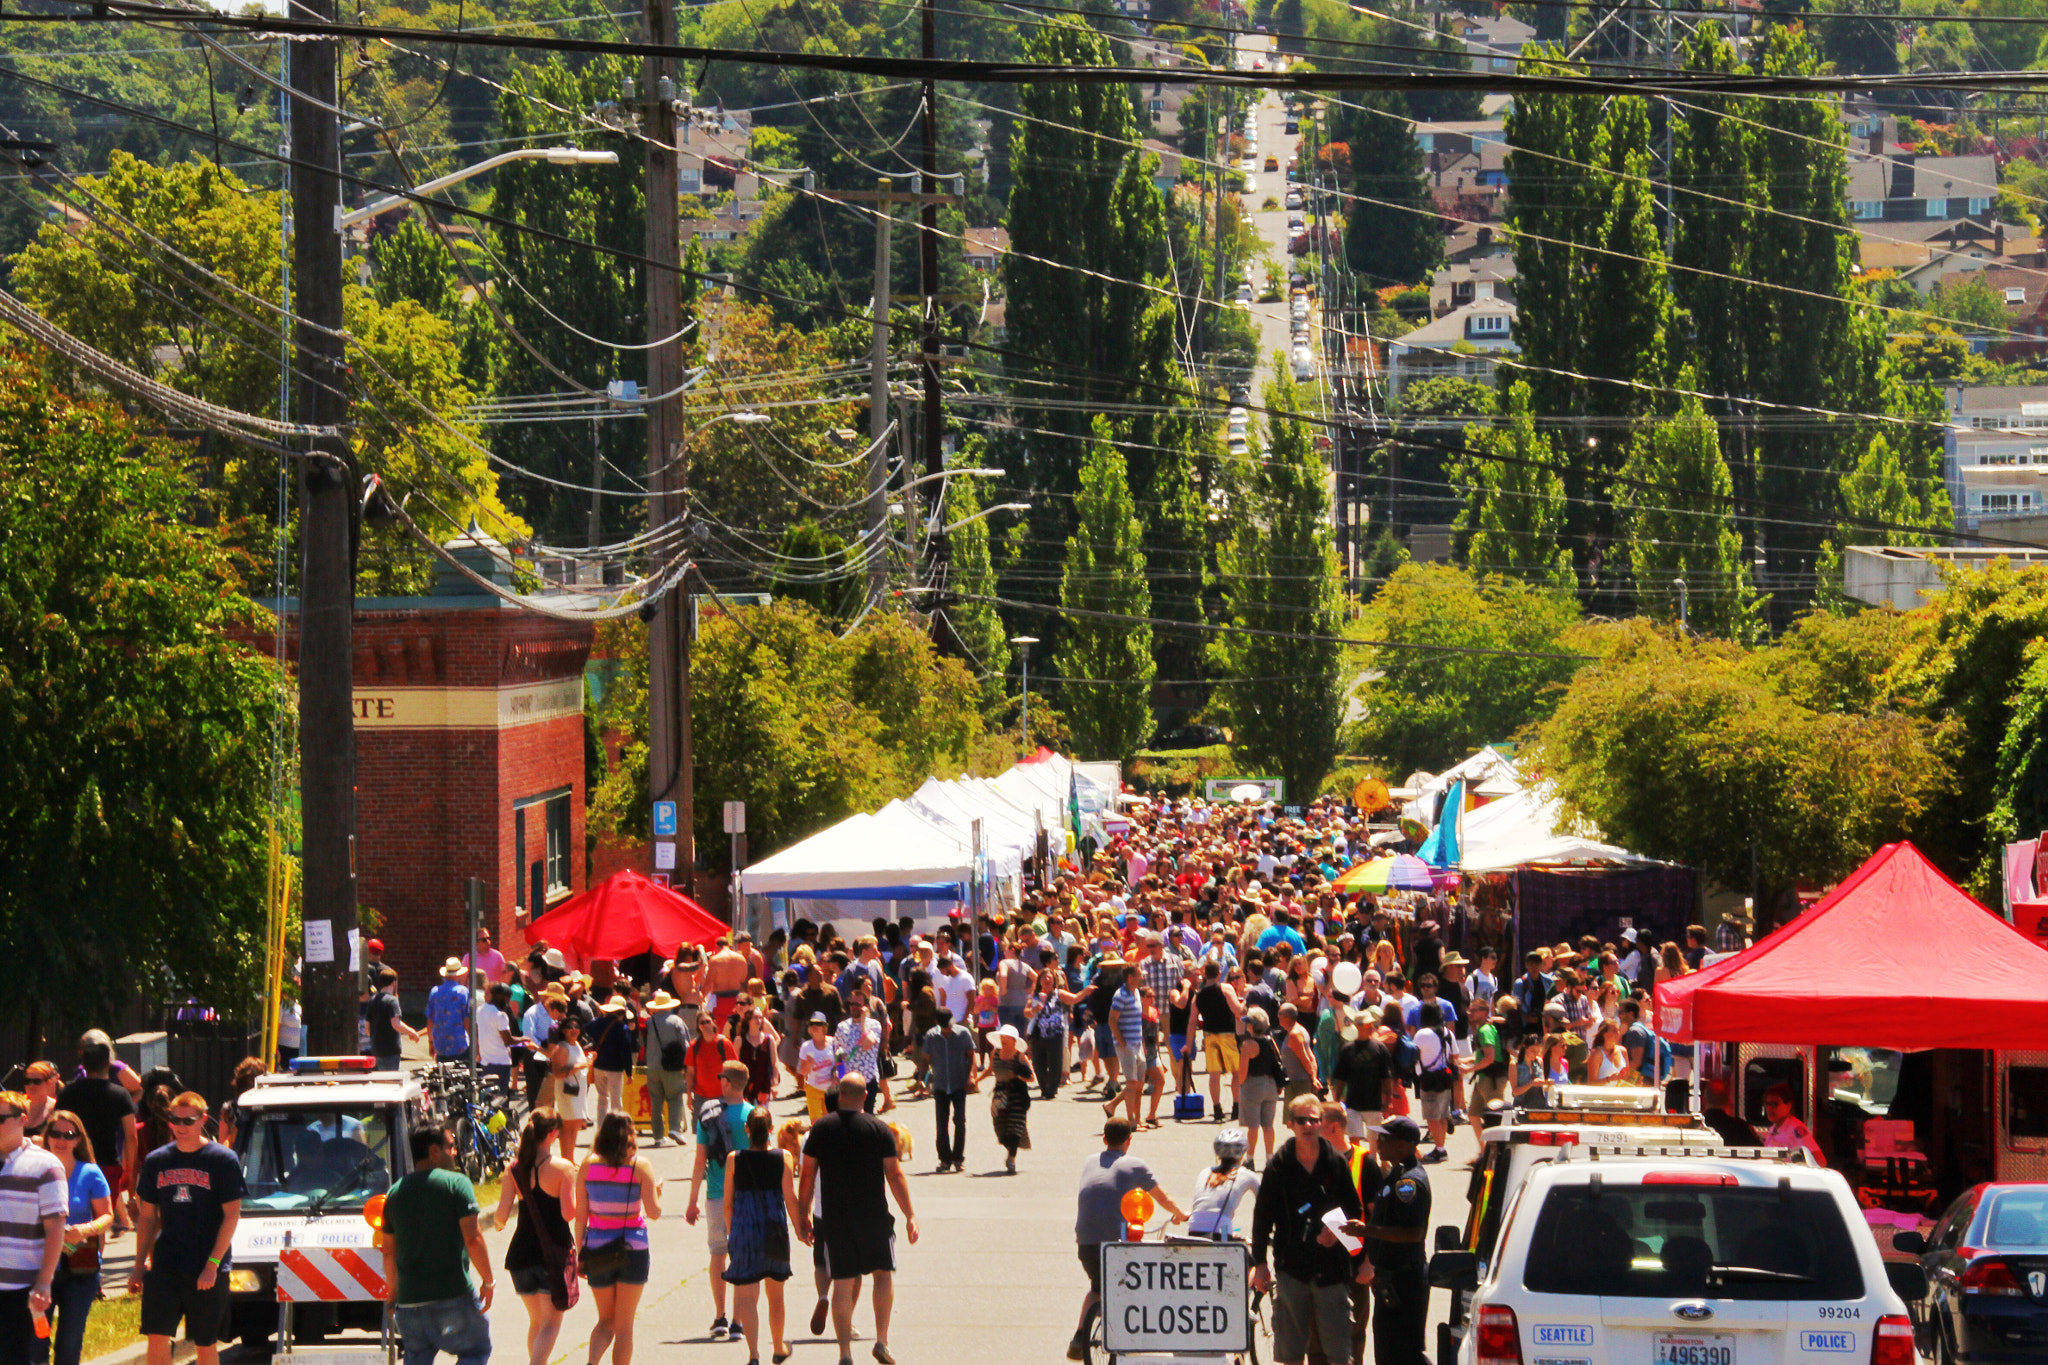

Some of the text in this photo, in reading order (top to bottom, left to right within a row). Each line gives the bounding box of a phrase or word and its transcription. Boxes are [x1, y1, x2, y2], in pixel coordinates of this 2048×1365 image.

[352, 698, 395, 719] TE
[659, 805, 673, 823] P
[1597, 1133, 1629, 1144] 78291
[157, 1168, 211, 1190] ARIZONA
[321, 1233, 359, 1245] POLICE
[1125, 1261, 1228, 1292] STREET
[1124, 1304, 1229, 1335] CLOSED
[1818, 1306, 1861, 1319] 99204
[1540, 1327, 1587, 1342] SEATTLE
[1660, 1338, 1704, 1346] WASHINGTON
[1808, 1334, 1848, 1349] POLICE
[1669, 1345, 1731, 1365] 49639D
